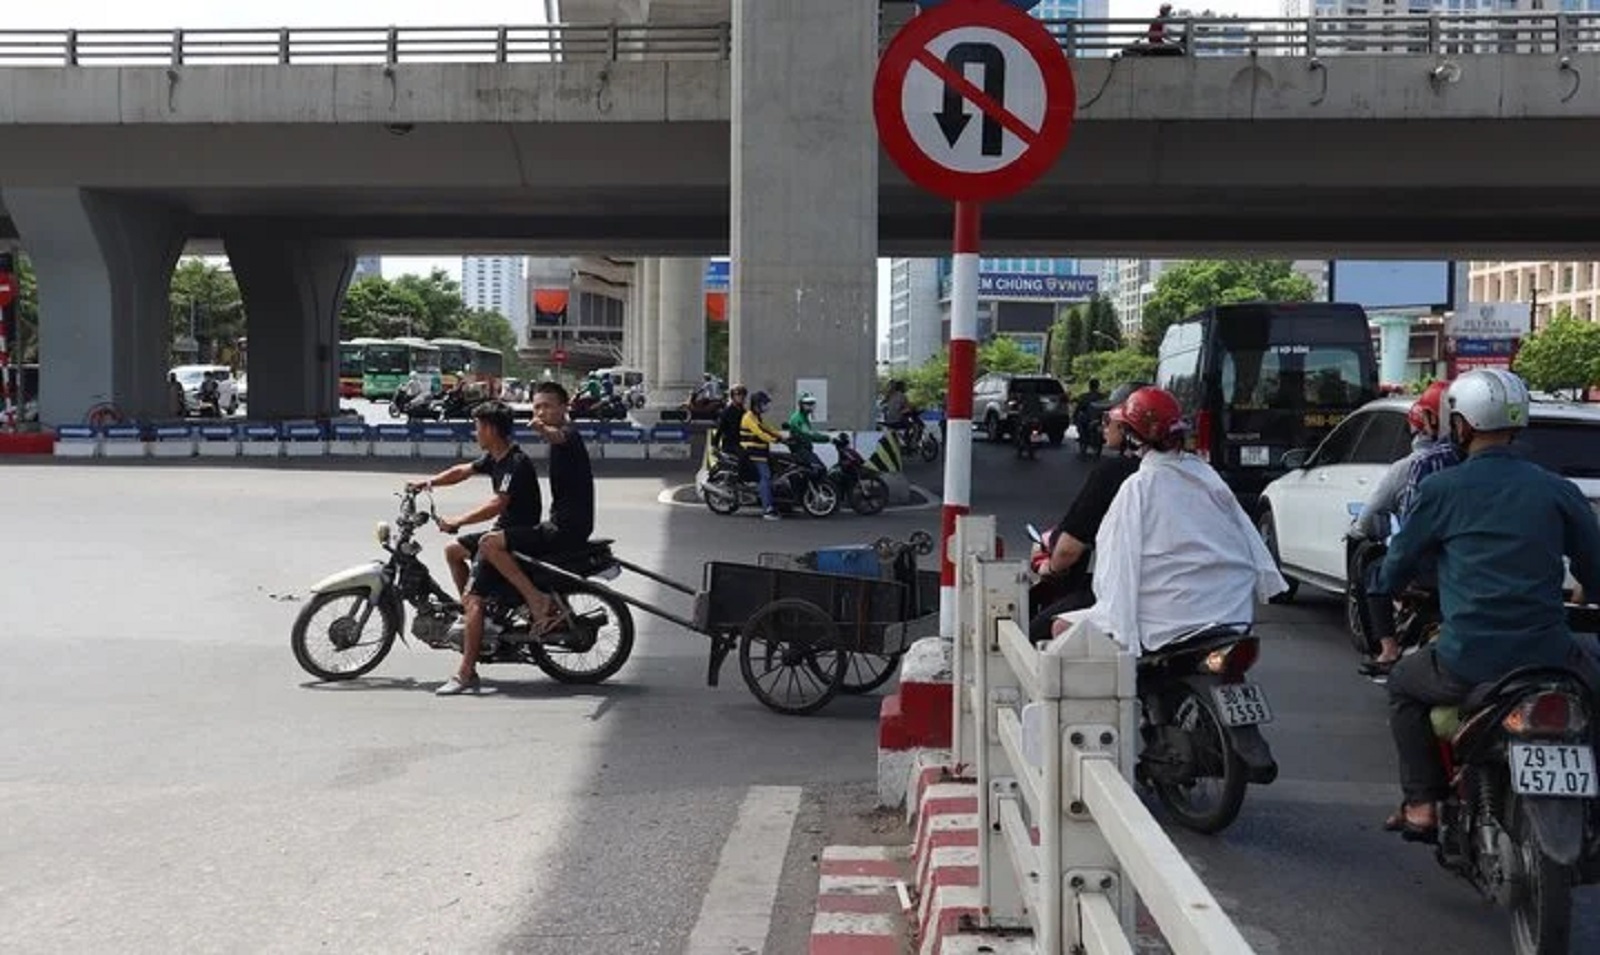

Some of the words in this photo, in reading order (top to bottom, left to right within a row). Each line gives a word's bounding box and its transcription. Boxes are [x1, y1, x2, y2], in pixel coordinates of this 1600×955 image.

[1060, 280, 1094, 292] VNVC
[1226, 703, 1265, 723] 2559
[1523, 746, 1580, 769] 29-T1
[1519, 769, 1590, 793] 457.07
